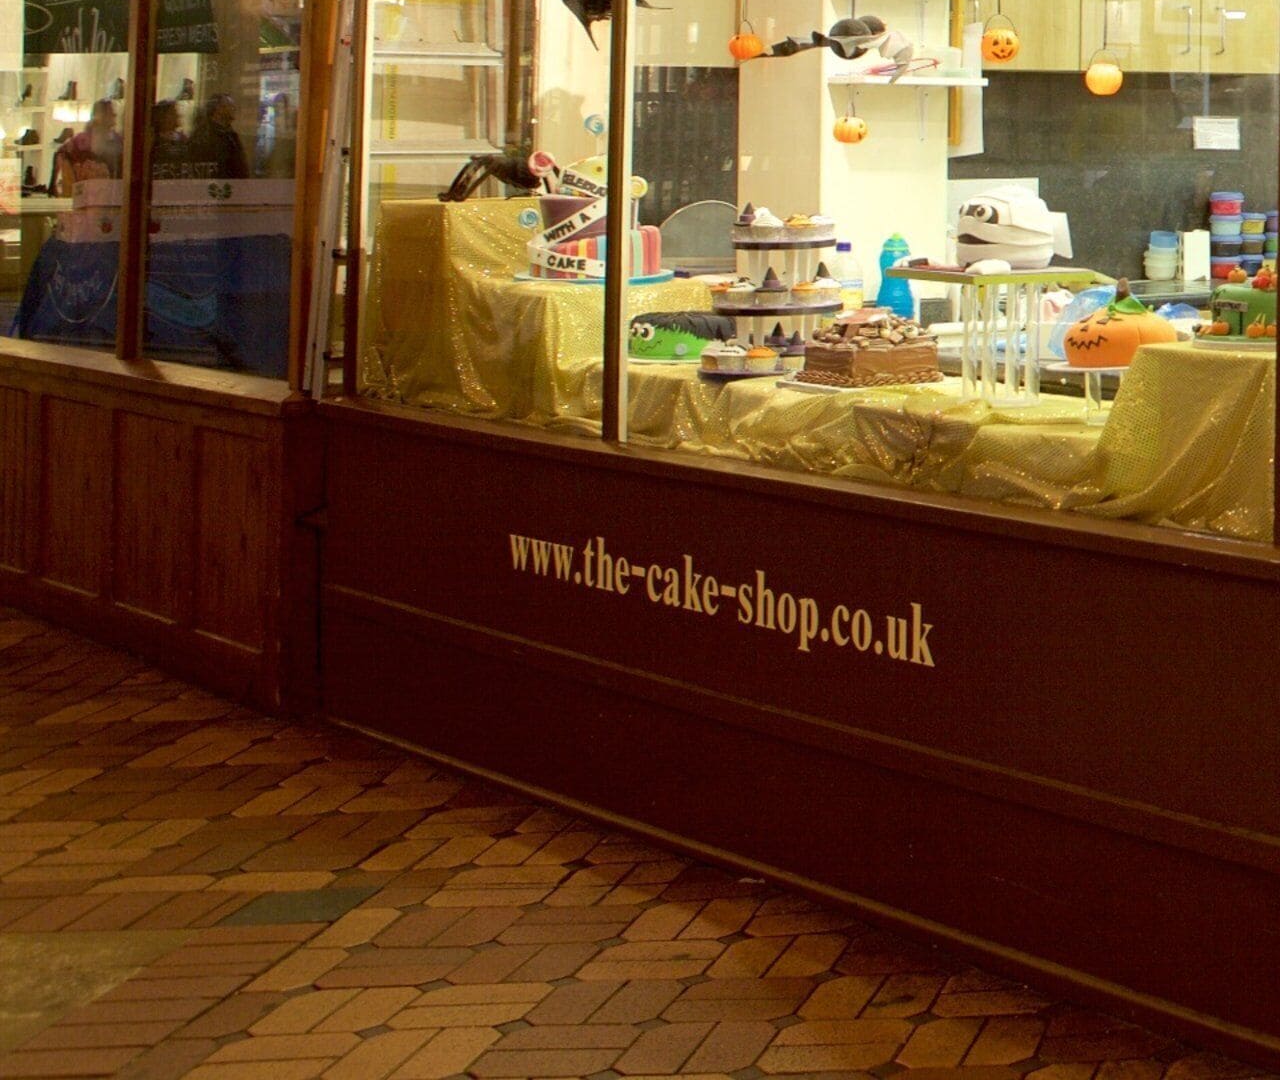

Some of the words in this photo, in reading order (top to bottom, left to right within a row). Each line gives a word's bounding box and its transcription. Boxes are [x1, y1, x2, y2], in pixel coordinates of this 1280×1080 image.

[543, 220, 576, 242] WITH
[579, 212, 591, 224] A
[547, 255, 587, 271] CAKE
[510, 533, 936, 668] www.the-cake-shop.co.uk
